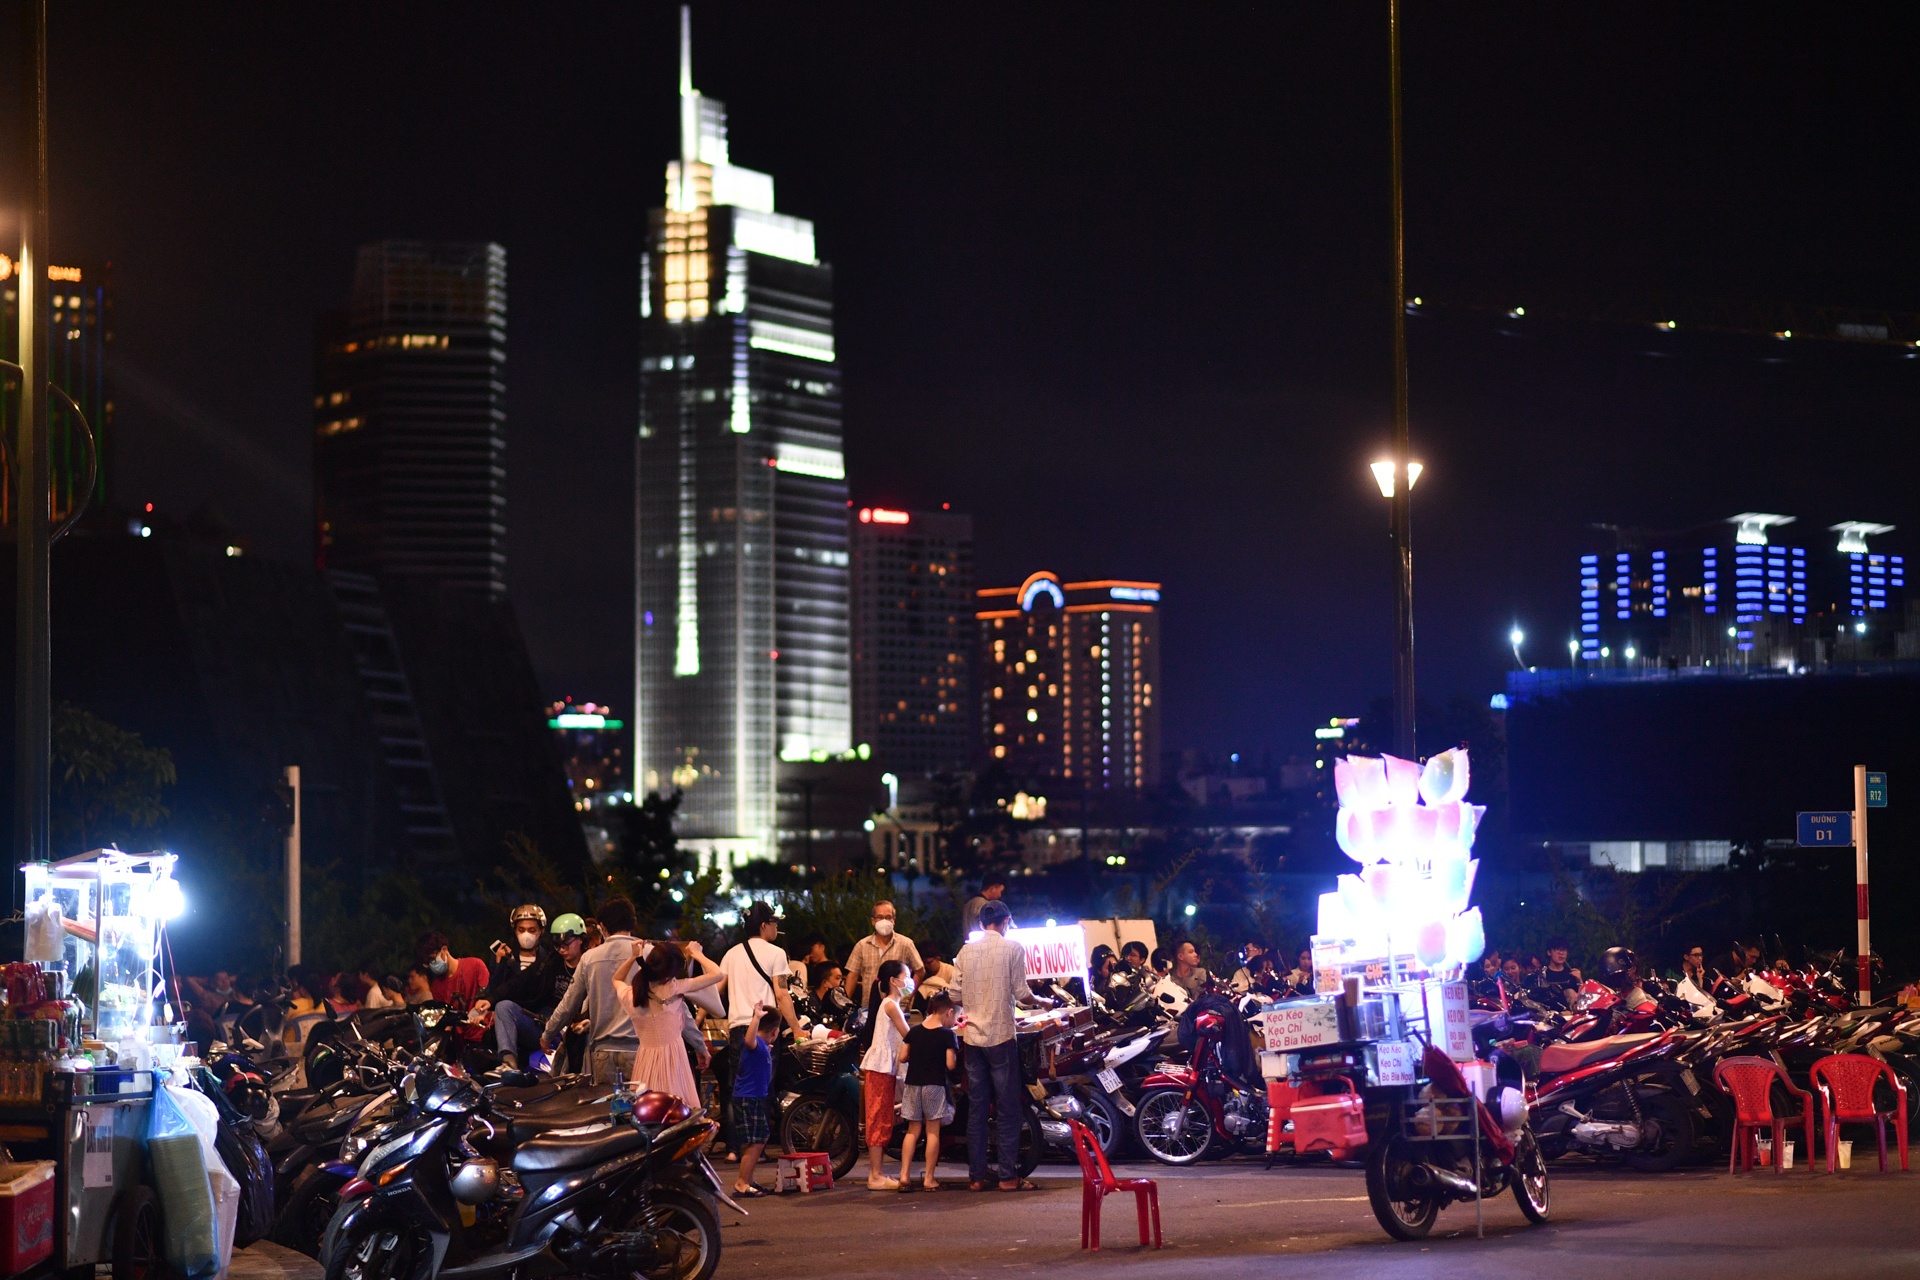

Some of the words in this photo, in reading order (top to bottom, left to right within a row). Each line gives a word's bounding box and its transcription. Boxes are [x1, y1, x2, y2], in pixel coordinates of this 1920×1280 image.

[1870, 790, 1882, 801] R12
[1811, 815, 1837, 823] ĐƯỜNG
[1816, 830, 1833, 841] D1
[1266, 1013, 1283, 1024] Kẹo
[1286, 1010, 1303, 1020] Kéo
[1268, 1026, 1285, 1037] Kẹo
[1287, 1022, 1302, 1033] Chỉ
[387, 1186, 412, 1196] HONDA
